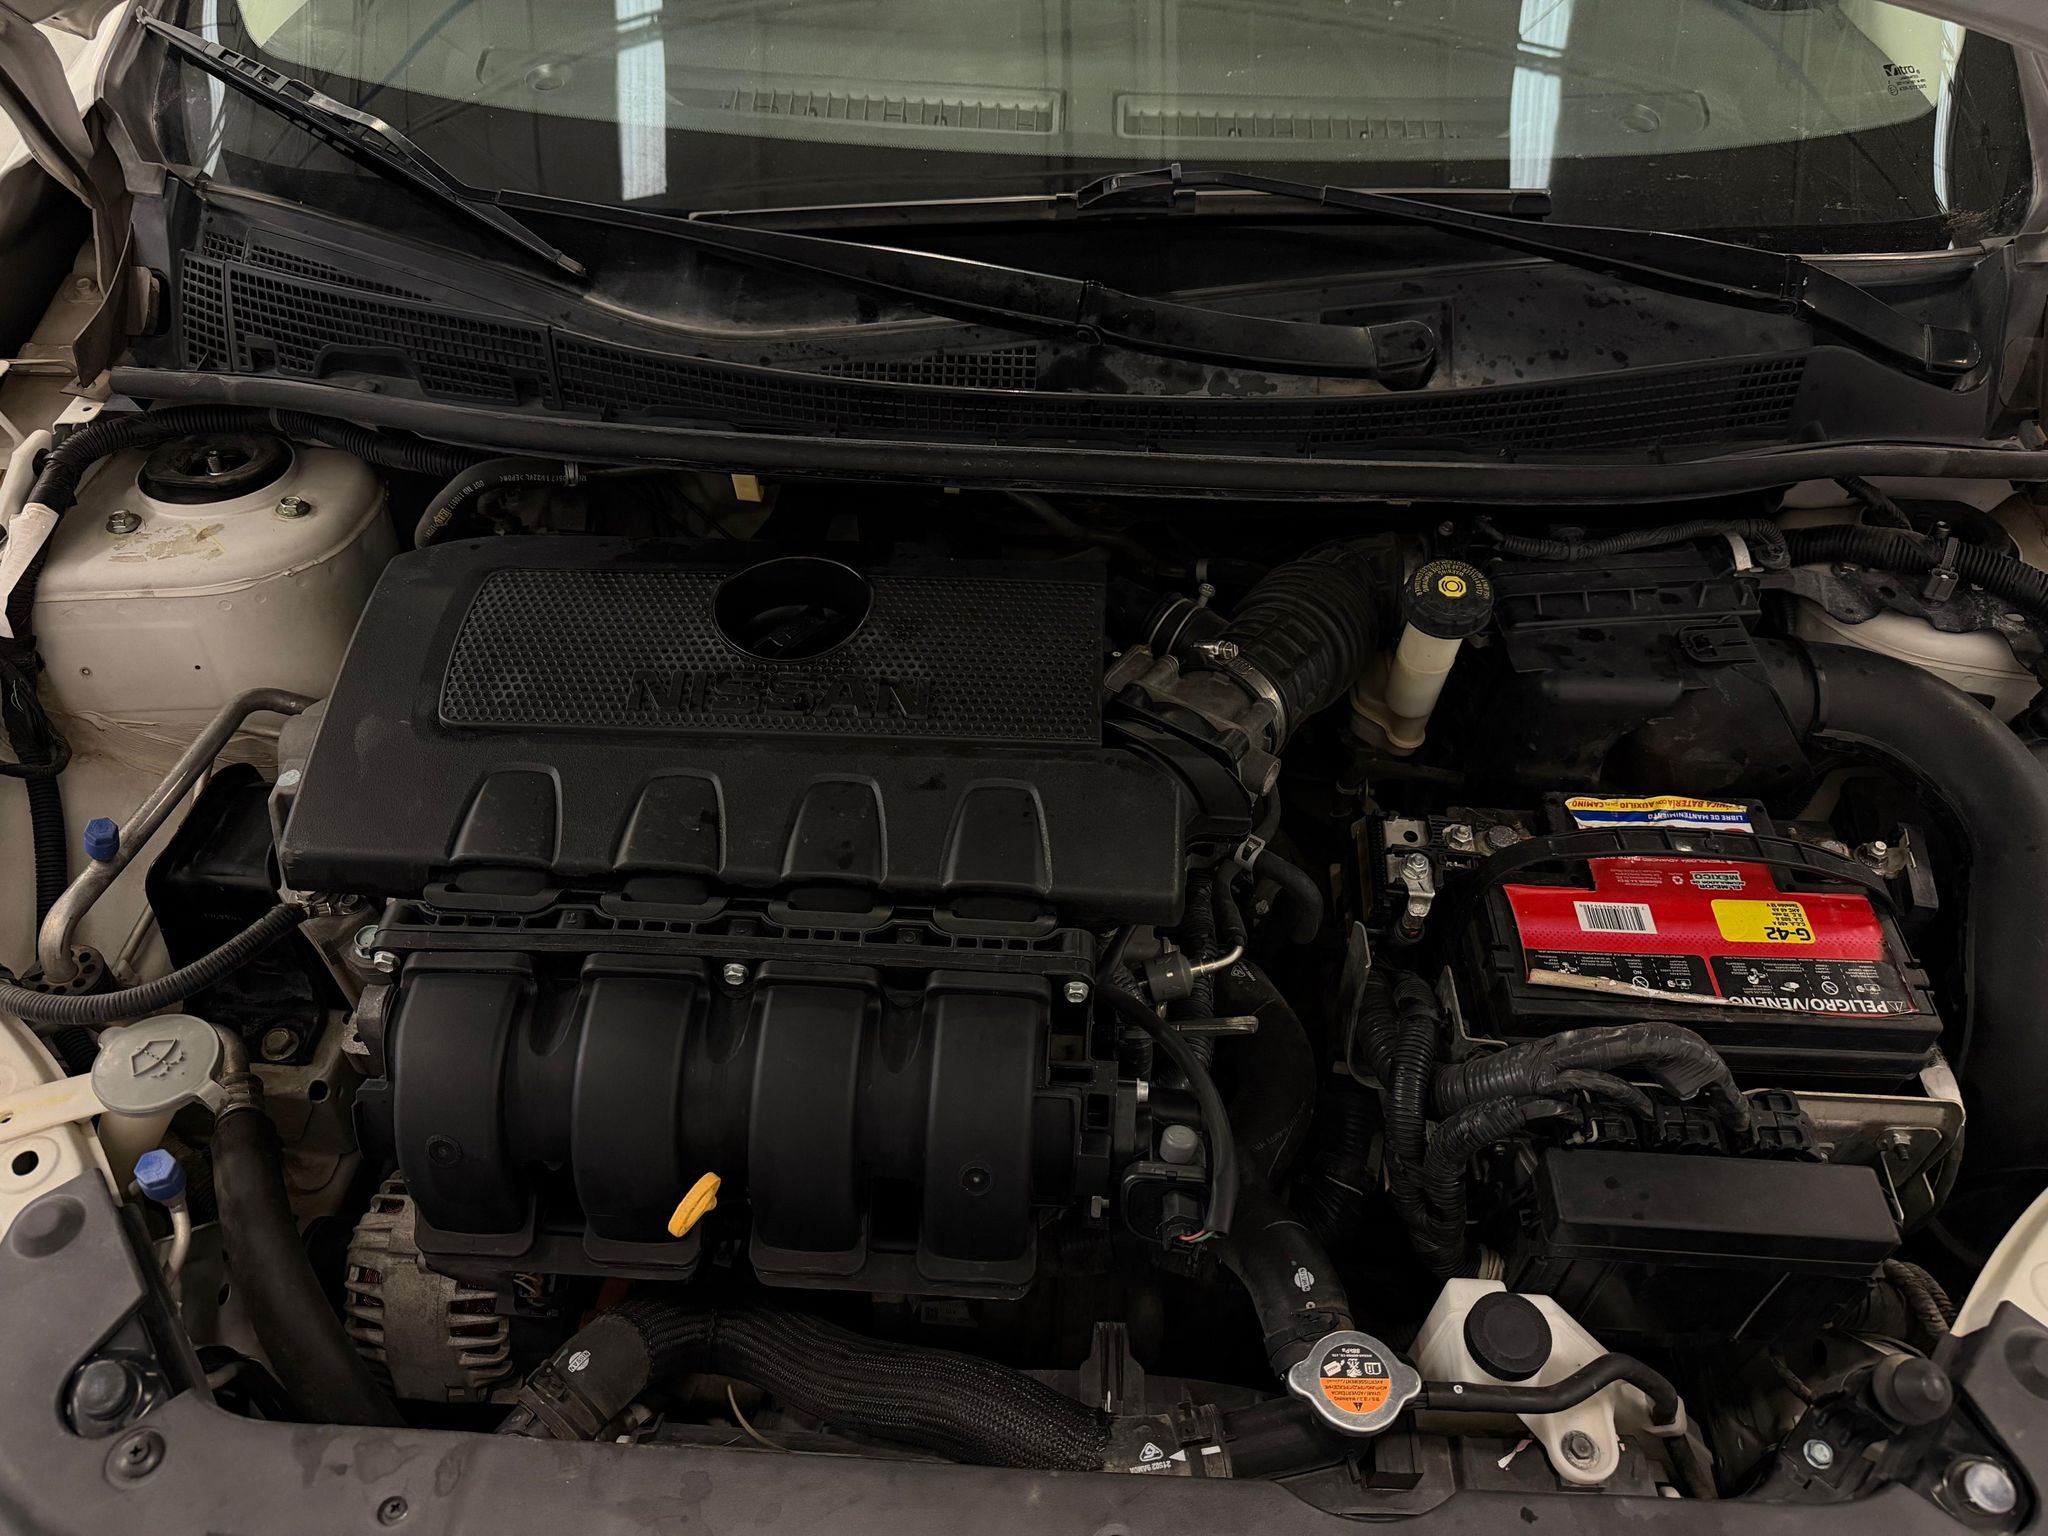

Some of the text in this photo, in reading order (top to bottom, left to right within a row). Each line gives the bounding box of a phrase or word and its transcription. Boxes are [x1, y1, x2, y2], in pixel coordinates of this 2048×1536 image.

[626, 669, 930, 721] NISSAN
[1572, 800, 1604, 808] CAMINO
[1668, 799, 1704, 809] BATERÍA
[1764, 927, 1811, 941] G-42
[1728, 996, 1888, 1013] PELIGRO/VENENO
